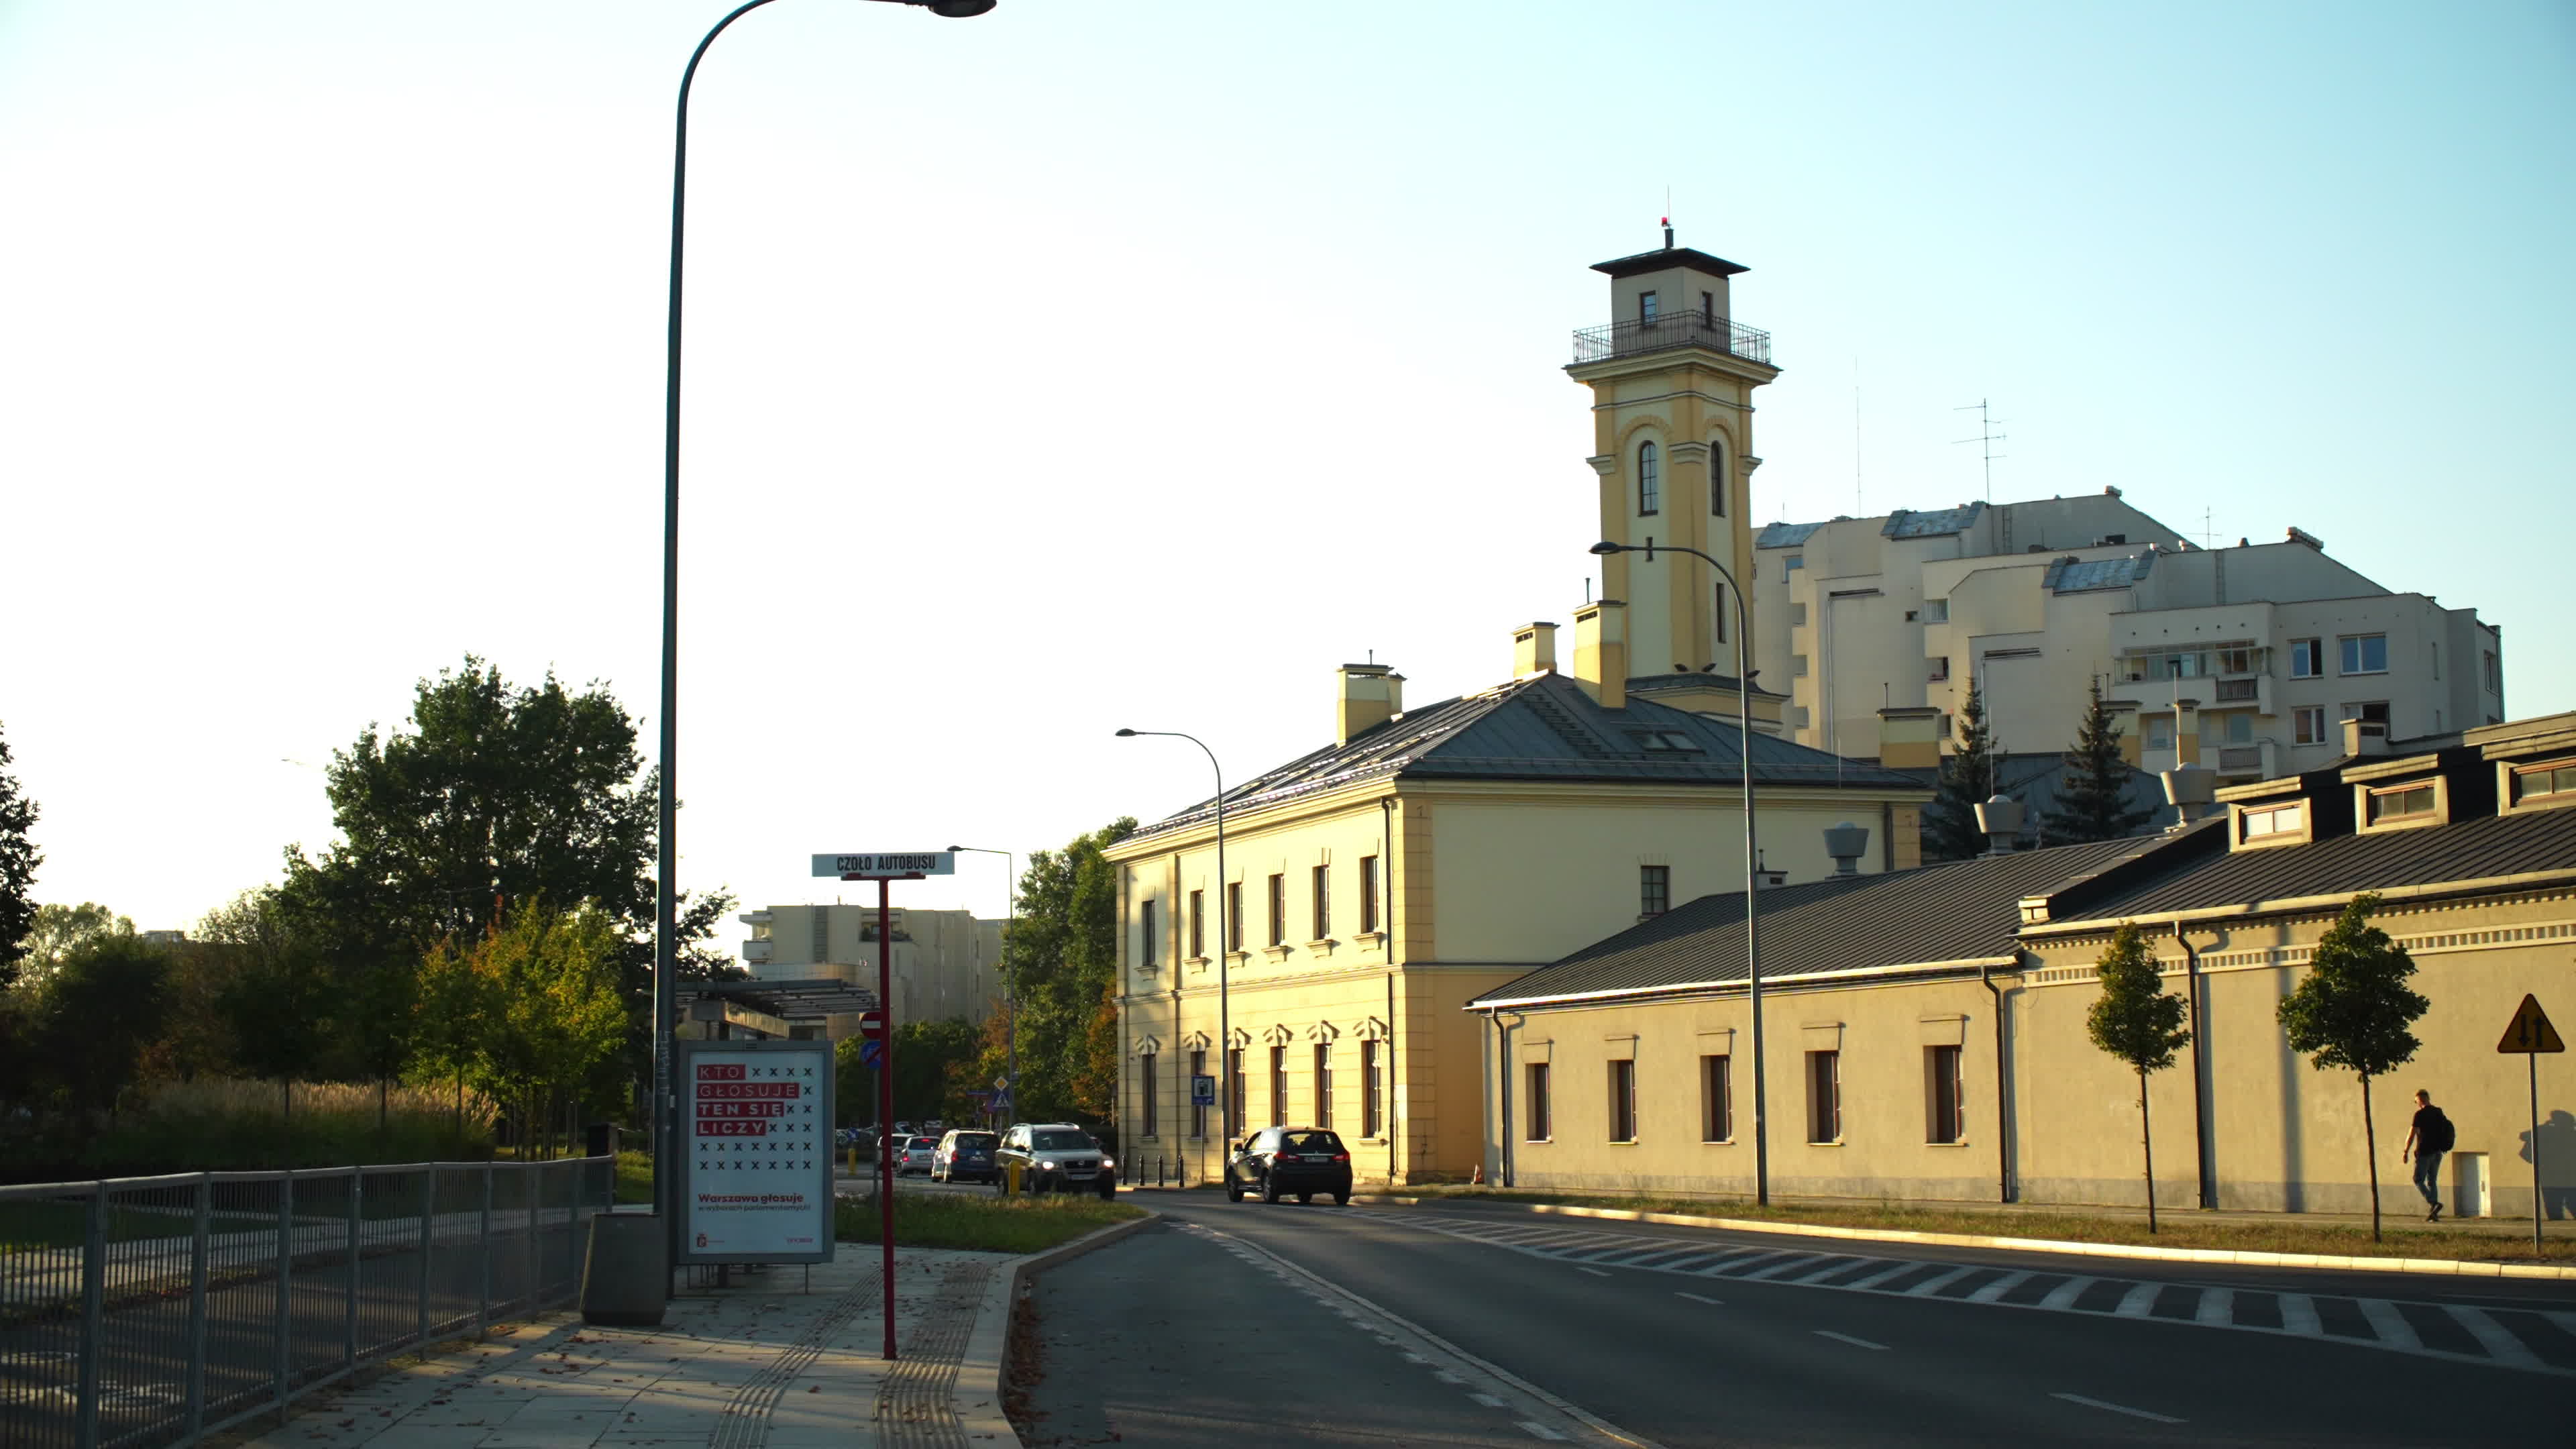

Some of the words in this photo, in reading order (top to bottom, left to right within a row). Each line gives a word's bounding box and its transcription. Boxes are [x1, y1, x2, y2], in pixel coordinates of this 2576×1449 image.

[837, 856, 872, 871] CZOŁO
[877, 854, 936, 870] AUTOBUSU
[700, 1067, 740, 1079] KTO
[700, 1084, 796, 1097] GŁOSUJE
[699, 1104, 739, 1116] TEN
[748, 1104, 782, 1118] SIĘ
[699, 1122, 763, 1134] LICZY
[698, 1193, 759, 1203] Warszawa
[761, 1193, 804, 1205] głosuje
